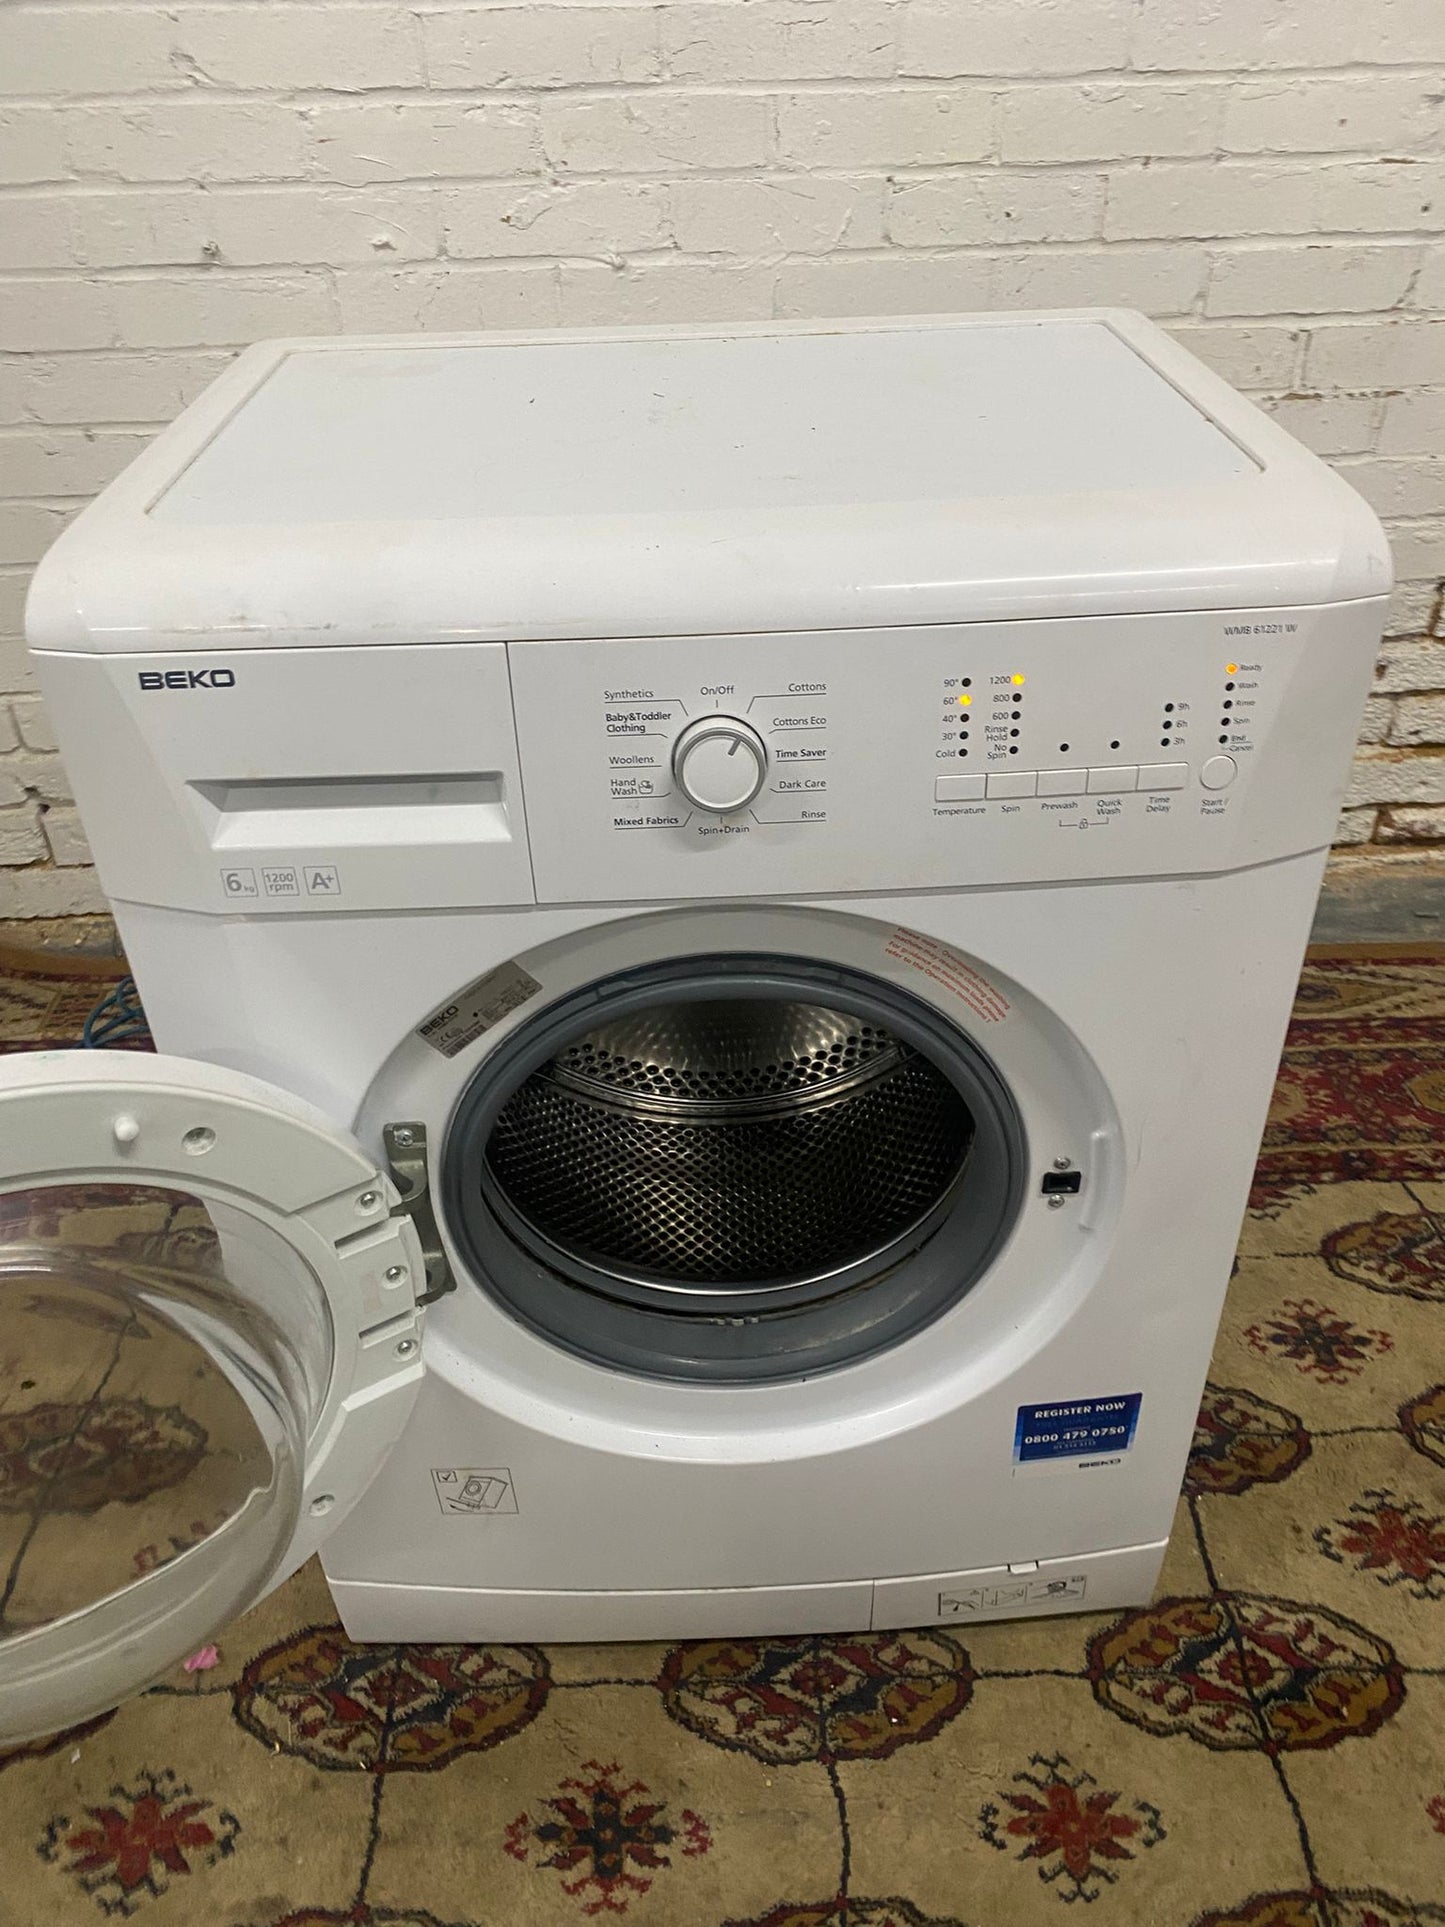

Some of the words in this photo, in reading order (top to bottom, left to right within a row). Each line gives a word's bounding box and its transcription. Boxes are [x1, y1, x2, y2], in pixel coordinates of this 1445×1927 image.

[138, 669, 236, 690] BEKO
[989, 676, 1011, 684] 1200
[700, 685, 735, 696] On/Off
[788, 683, 827, 692] Cottons
[604, 689, 654, 700] Synthetics
[993, 694, 1010, 702] 800
[1178, 703, 1190, 711] 9h
[605, 711, 672, 722] Baby&Toddler
[992, 712, 1009, 720] 600
[773, 717, 809, 727] Cottons
[810, 716, 827, 725] Eco
[1176, 720, 1188, 728] 6h
[606, 723, 646, 733] Clothing
[984, 725, 1008, 734] Rinse
[986, 733, 1008, 742] Hold
[994, 744, 1007, 752] No
[775, 749, 798, 758] Time
[800, 748, 827, 757] Saver
[935, 750, 956, 759] Cold
[987, 752, 1007, 761] Spin
[609, 755, 654, 764] Woollens
[610, 778, 636, 787] Hand
[779, 780, 802, 789] Dark
[804, 779, 827, 788] Care
[611, 787, 638, 796] Wash
[1097, 799, 1122, 807] Quick
[1148, 796, 1170, 804] Time
[1001, 805, 1020, 813] Spin
[1041, 802, 1078, 810] Prewash
[1146, 804, 1171, 813] Delay
[801, 810, 826, 819] Rinse
[932, 807, 986, 817] Temperature
[1097, 807, 1121, 815] Wash
[1200, 807, 1225, 815] Pause
[613, 817, 644, 827] Mixed
[646, 816, 679, 825] Fabrics
[698, 825, 750, 835] Spin+Drain
[226, 873, 242, 892] 6
[265, 873, 294, 883] 1200
[311, 872, 335, 889] A+
[269, 882, 294, 893] rpm
[420, 1005, 459, 1036] BEKO
[1034, 1405, 1092, 1419] REGISTER
[1096, 1401, 1126, 1412] NOW
[1024, 1433, 1059, 1444] 0800
[1062, 1430, 1088, 1440] 479
